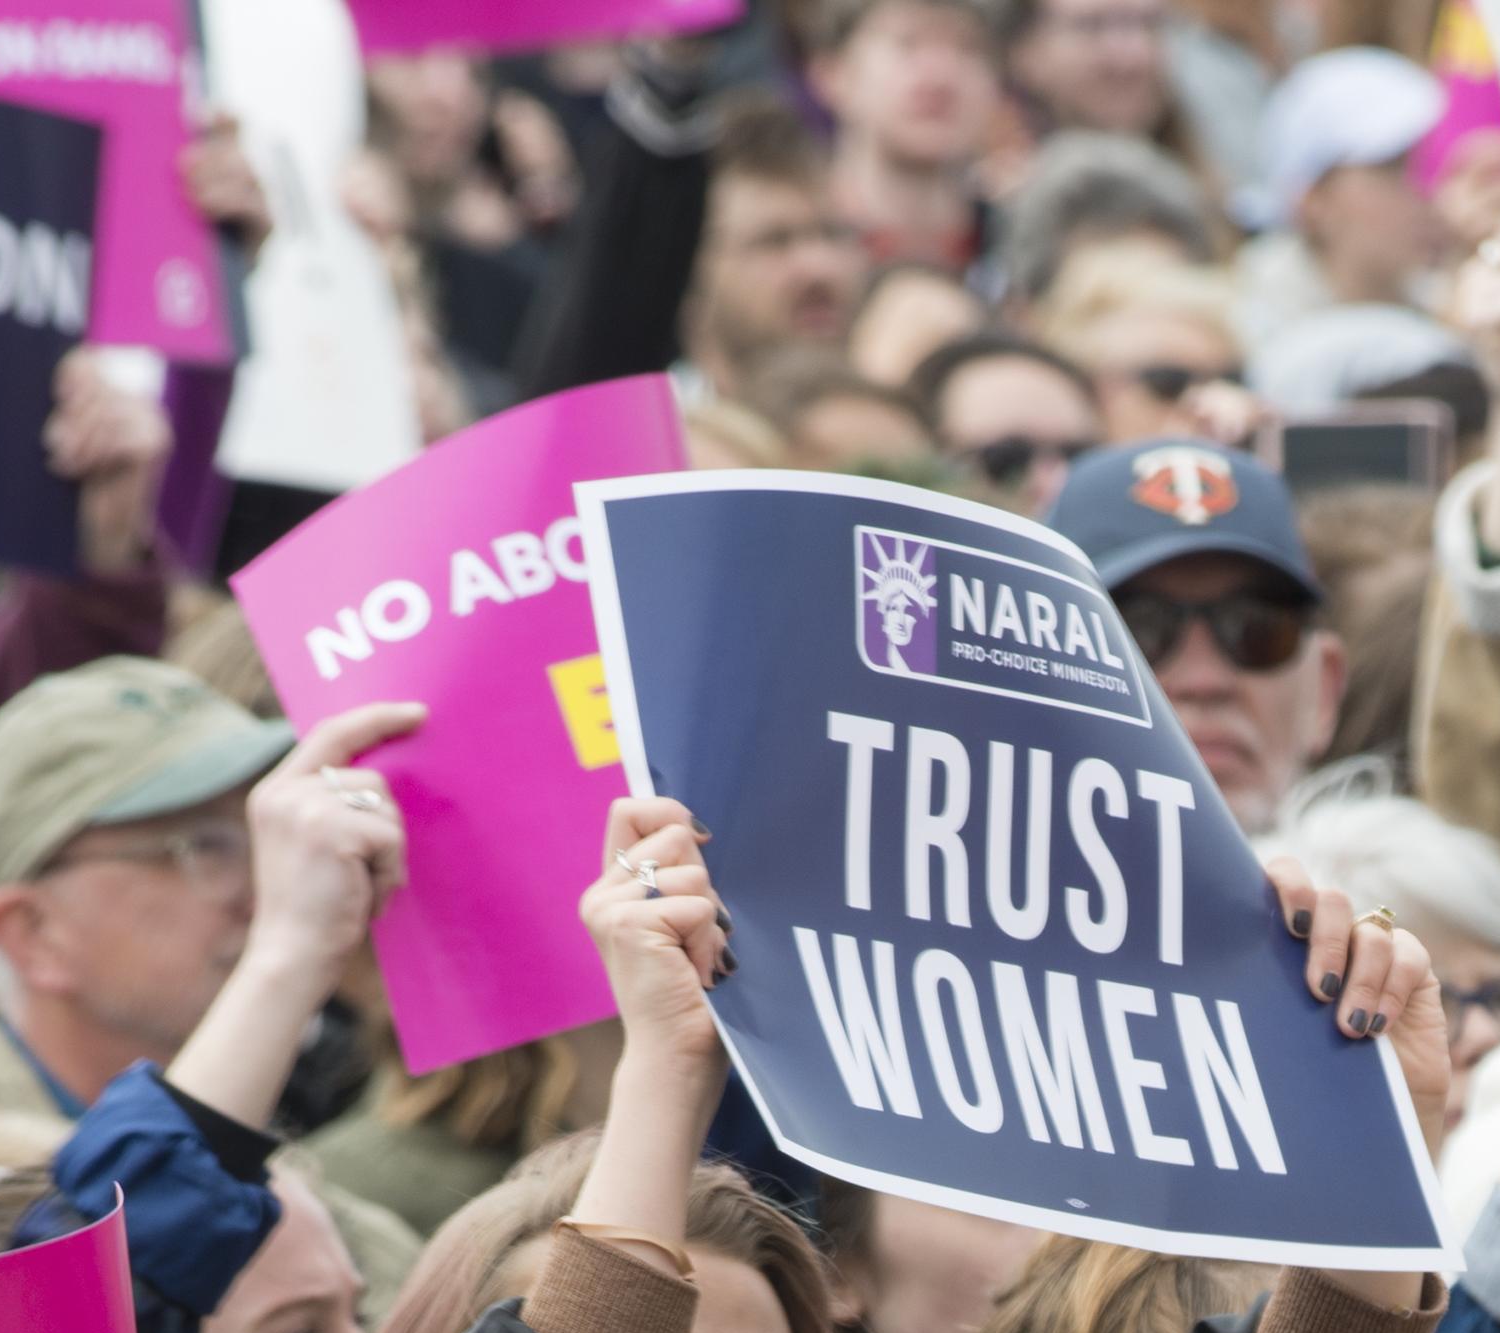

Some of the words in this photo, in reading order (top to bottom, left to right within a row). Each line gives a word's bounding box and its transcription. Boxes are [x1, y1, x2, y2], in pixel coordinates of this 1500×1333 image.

[305, 579, 432, 682] NO
[949, 572, 1125, 670] NARAL
[951, 640, 1049, 677] PRO-CHOICE
[1052, 661, 1131, 697] MINNESOTA
[826, 709, 1196, 966] TRUST
[792, 926, 1288, 1175] WOMEN
